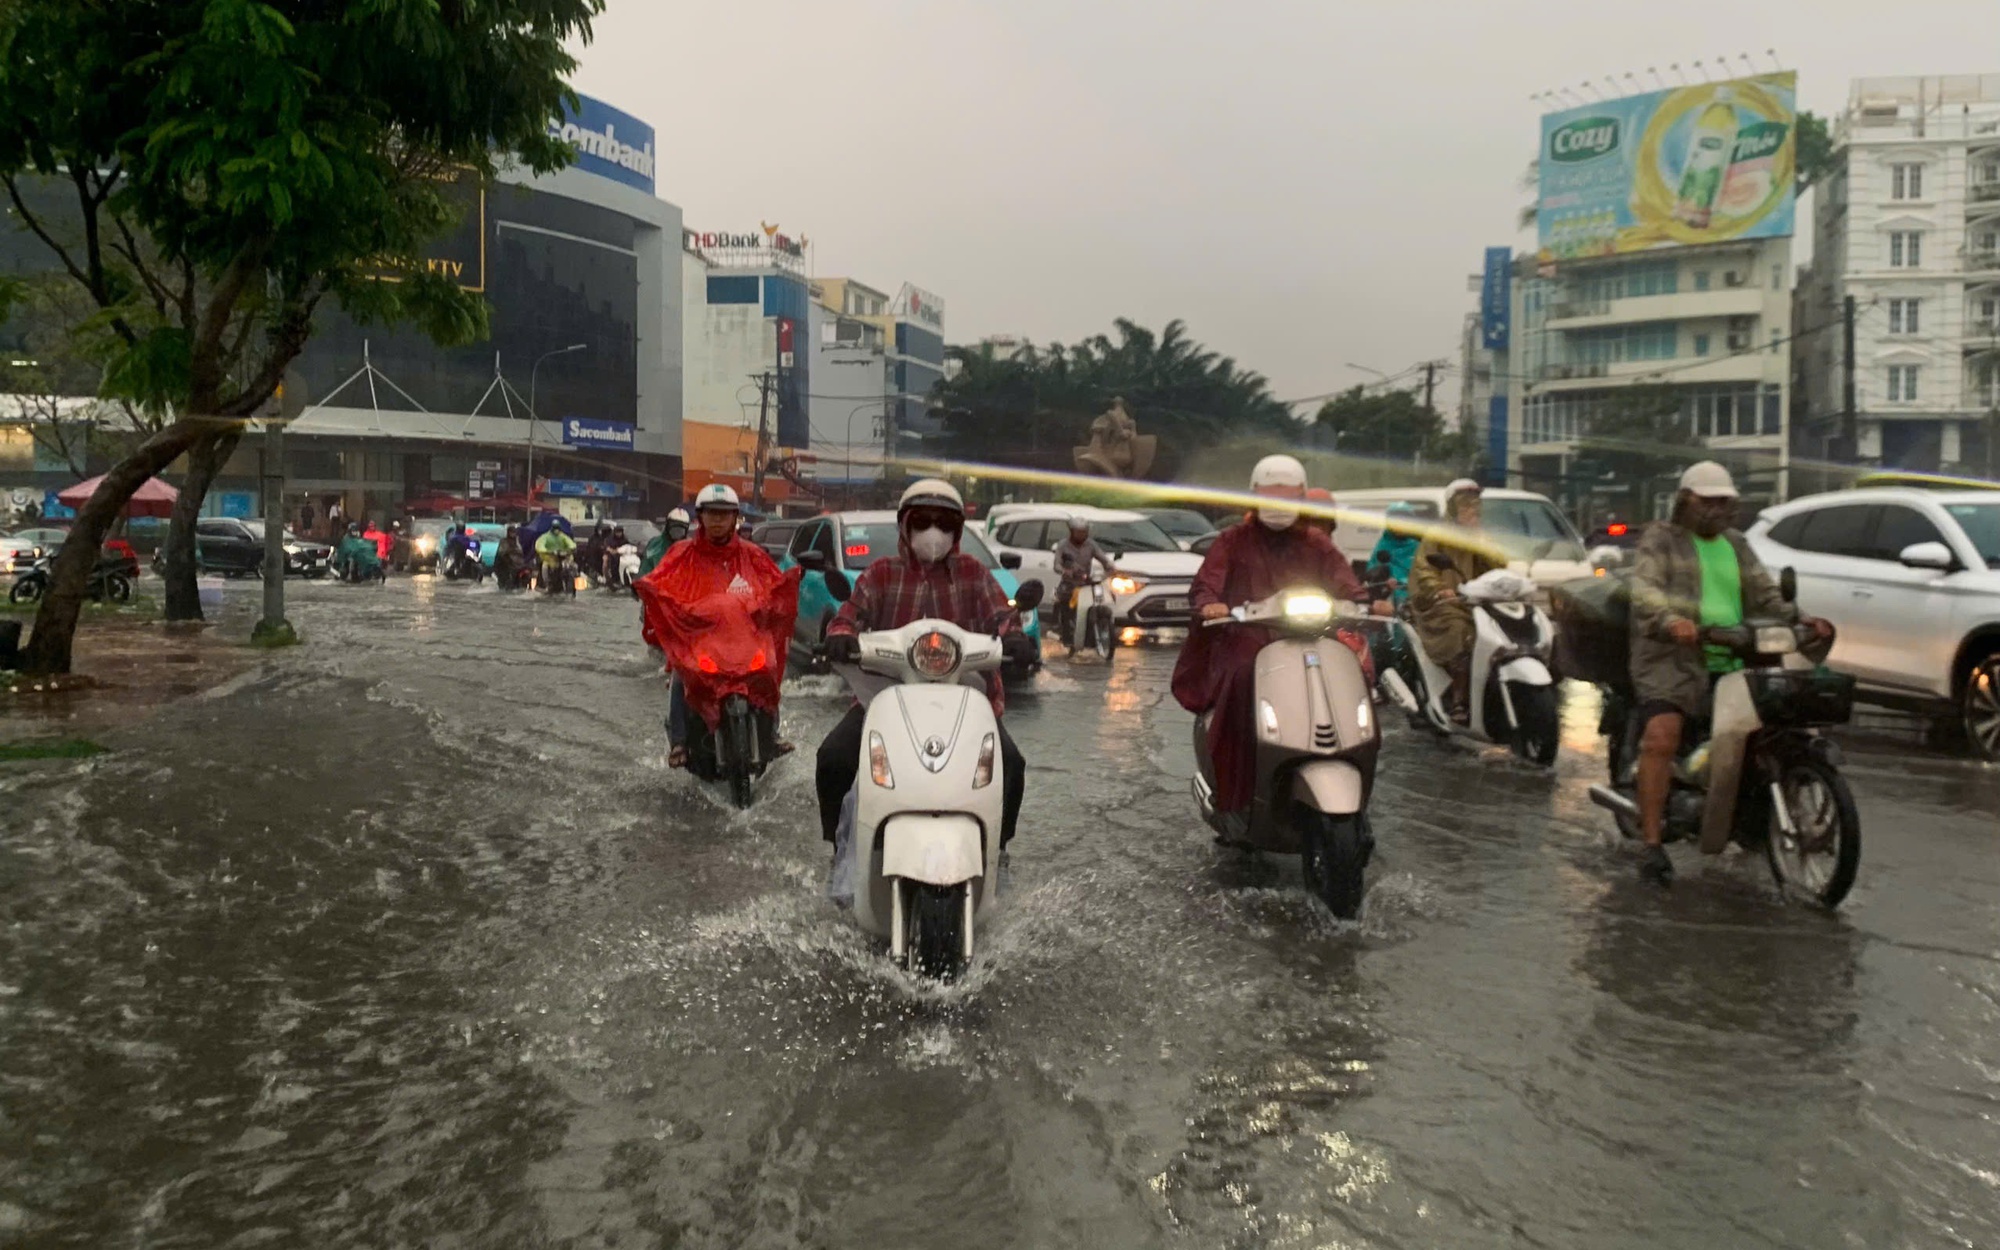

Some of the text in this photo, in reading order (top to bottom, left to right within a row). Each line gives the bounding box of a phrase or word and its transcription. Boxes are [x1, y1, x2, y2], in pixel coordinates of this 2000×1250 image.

[545, 116, 654, 180] combank
[1554, 125, 1616, 154] Cozy
[695, 231, 760, 248] HDBank
[427, 258, 463, 277] KTV
[569, 420, 632, 443] Sacombank
